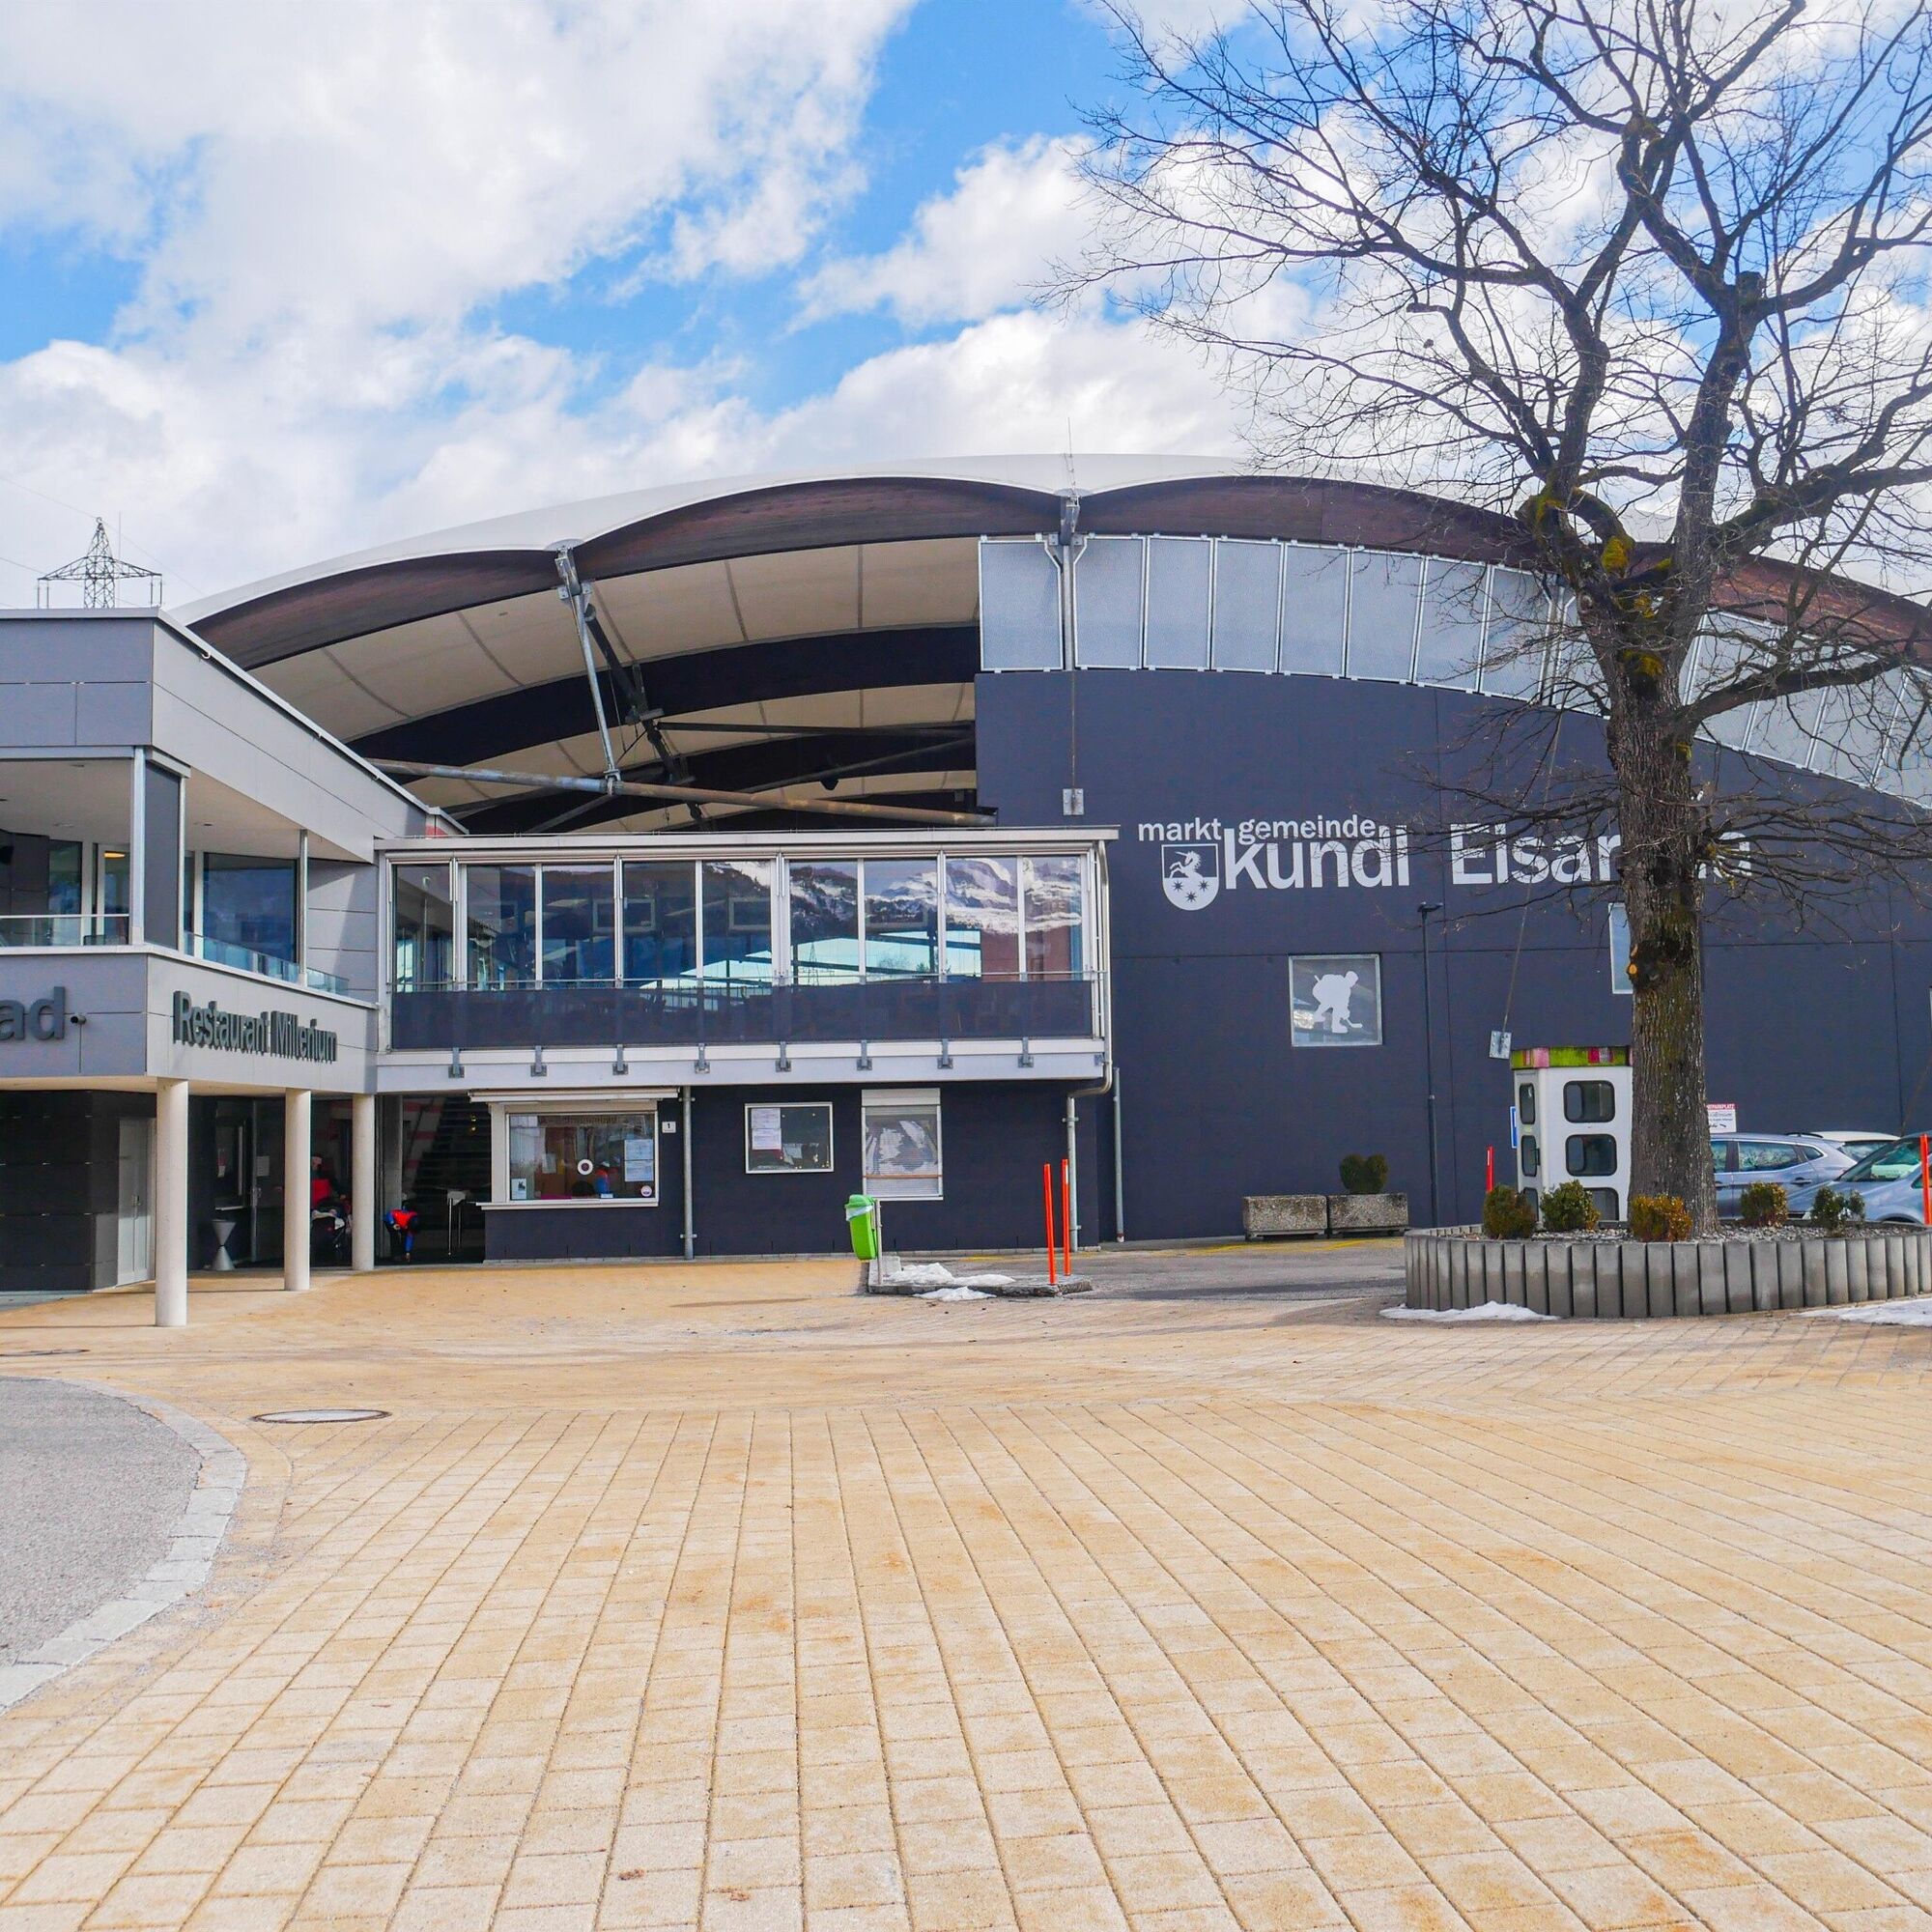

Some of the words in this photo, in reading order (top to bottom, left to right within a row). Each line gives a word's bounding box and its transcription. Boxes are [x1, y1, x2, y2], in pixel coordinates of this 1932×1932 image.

[1138, 817, 1222, 841] markt
[1237, 814, 1377, 845] gemeinde
[1224, 825, 1410, 889] kundl
[1450, 823, 1751, 884] Eisara
[173, 990, 269, 1056] Restaurant
